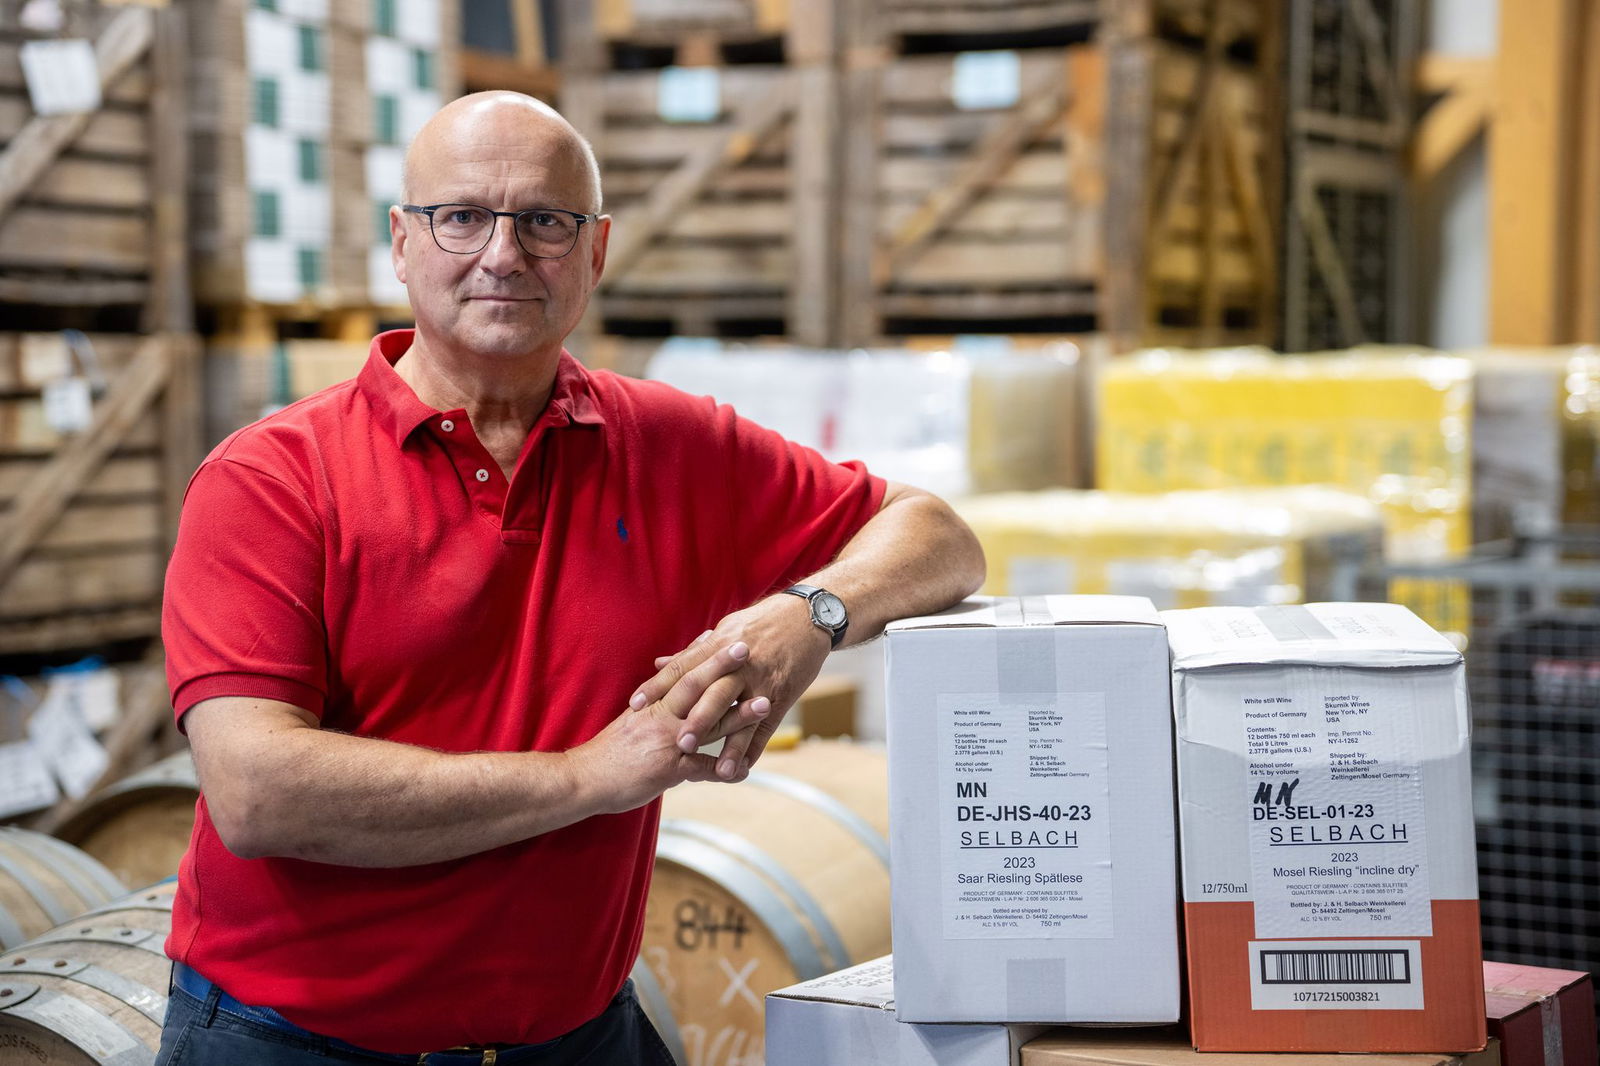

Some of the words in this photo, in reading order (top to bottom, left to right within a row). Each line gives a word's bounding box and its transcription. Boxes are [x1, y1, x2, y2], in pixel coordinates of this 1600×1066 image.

[957, 782, 987, 798] MN
[1254, 778, 1299, 807] MN
[958, 805, 1092, 822] DE-JHS-40-23
[1253, 804, 1374, 821] DE-SEL-01-23
[961, 830, 1077, 846] SELBACH
[1270, 823, 1407, 843] SELBACH
[1004, 857, 1036, 869] 2023
[1331, 852, 1359, 863] 2023
[958, 873, 984, 884] Saar
[987, 873, 1031, 886] Riesling
[1035, 872, 1083, 885] Spätlese
[1273, 867, 1306, 878] Mosel
[1309, 866, 1352, 879] Riesling
[1202, 883, 1248, 894] 12/750ml
[1294, 992, 1380, 1002] 10717215003821
